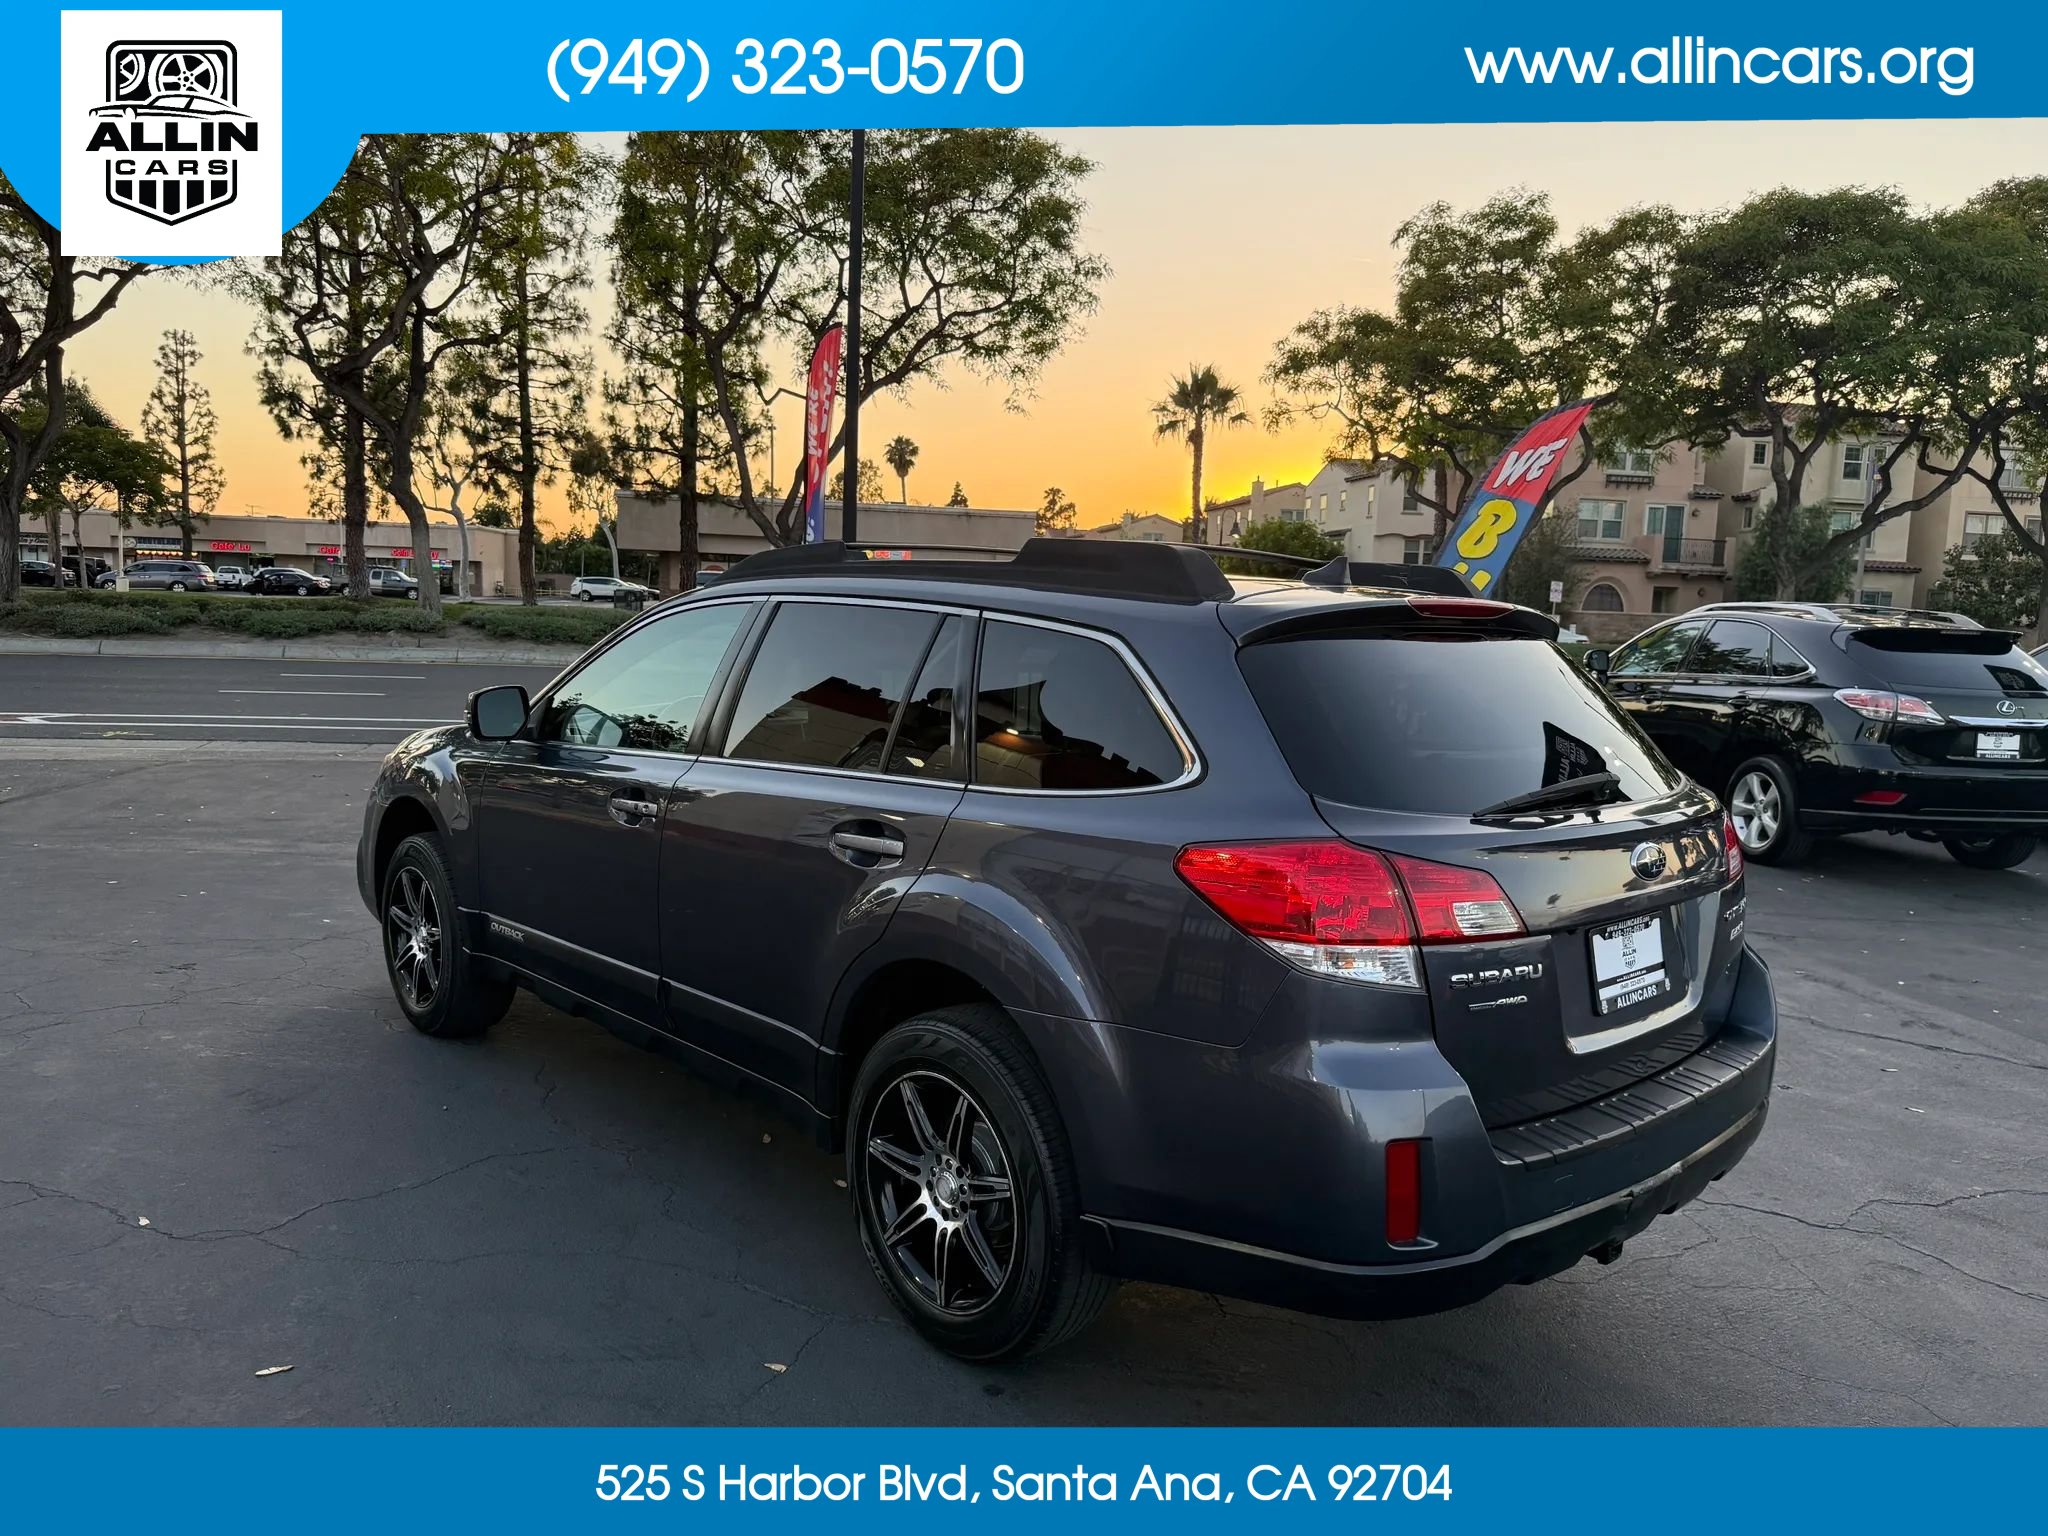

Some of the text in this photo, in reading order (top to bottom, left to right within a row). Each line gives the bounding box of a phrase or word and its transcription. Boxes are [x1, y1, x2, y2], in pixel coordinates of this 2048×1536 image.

[1492, 437, 1569, 489] WE
[490, 922, 525, 941] OUTBACK
[1450, 964, 1542, 989] SUBARU
[1617, 985, 1657, 1008] ALLINCARS
